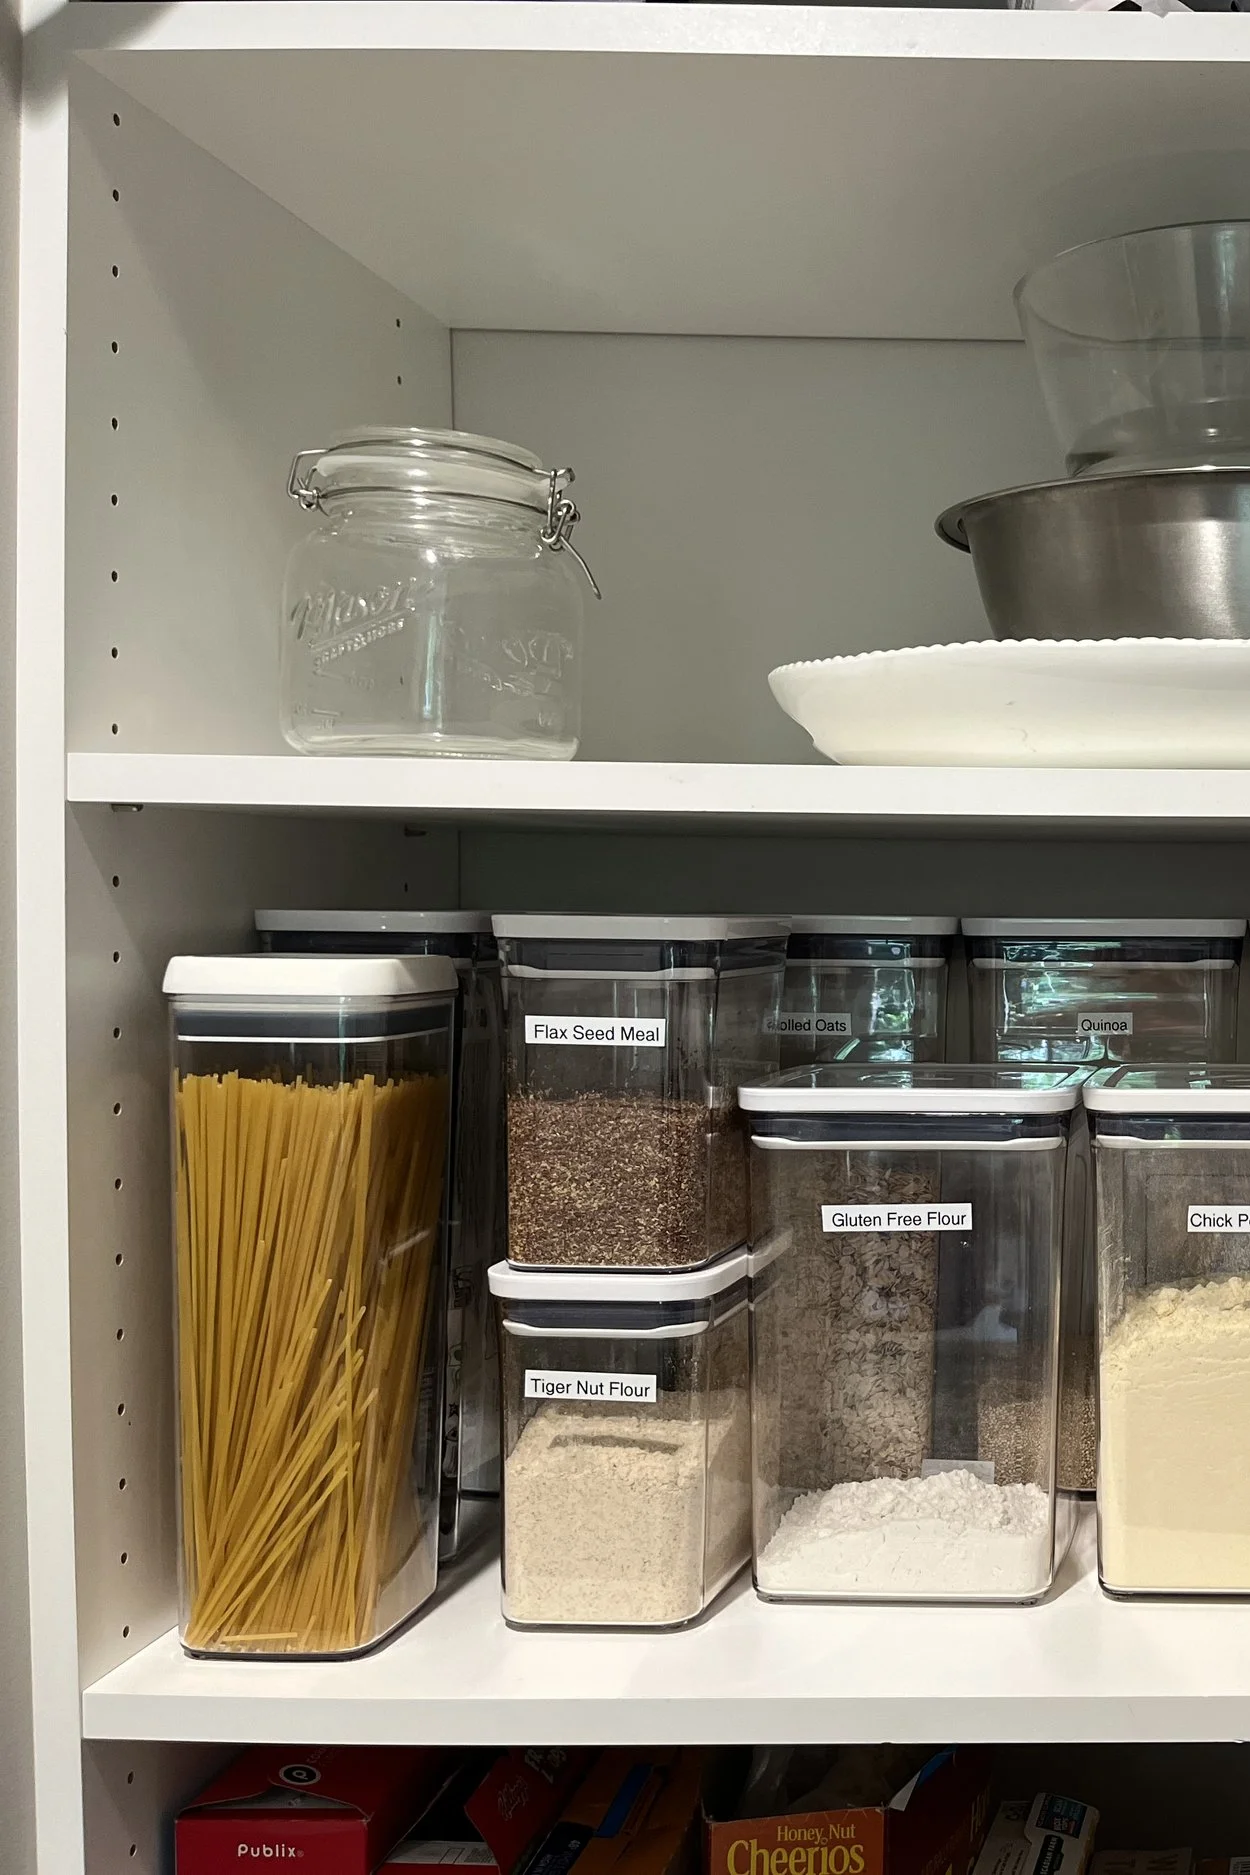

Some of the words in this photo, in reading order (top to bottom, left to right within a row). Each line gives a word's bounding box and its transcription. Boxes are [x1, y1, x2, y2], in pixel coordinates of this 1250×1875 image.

[533, 1024, 568, 1040] Flax
[573, 1024, 614, 1041] Seed
[621, 1026, 659, 1042] Meal
[815, 1019, 847, 1032] Oats
[1081, 1018, 1128, 1034] Quinoa
[832, 1212, 881, 1228] Gluten
[887, 1211, 922, 1226] Free
[927, 1211, 966, 1226] Flour
[1190, 1212, 1232, 1229] Chick
[530, 1378, 572, 1396] Tiger
[577, 1381, 604, 1396] Nut
[609, 1382, 650, 1398] Flour
[777, 1825, 824, 1845] Honey
[829, 1824, 856, 1839] Nut
[237, 1843, 296, 1858] Publix
[727, 1839, 865, 1875] Cheerios
